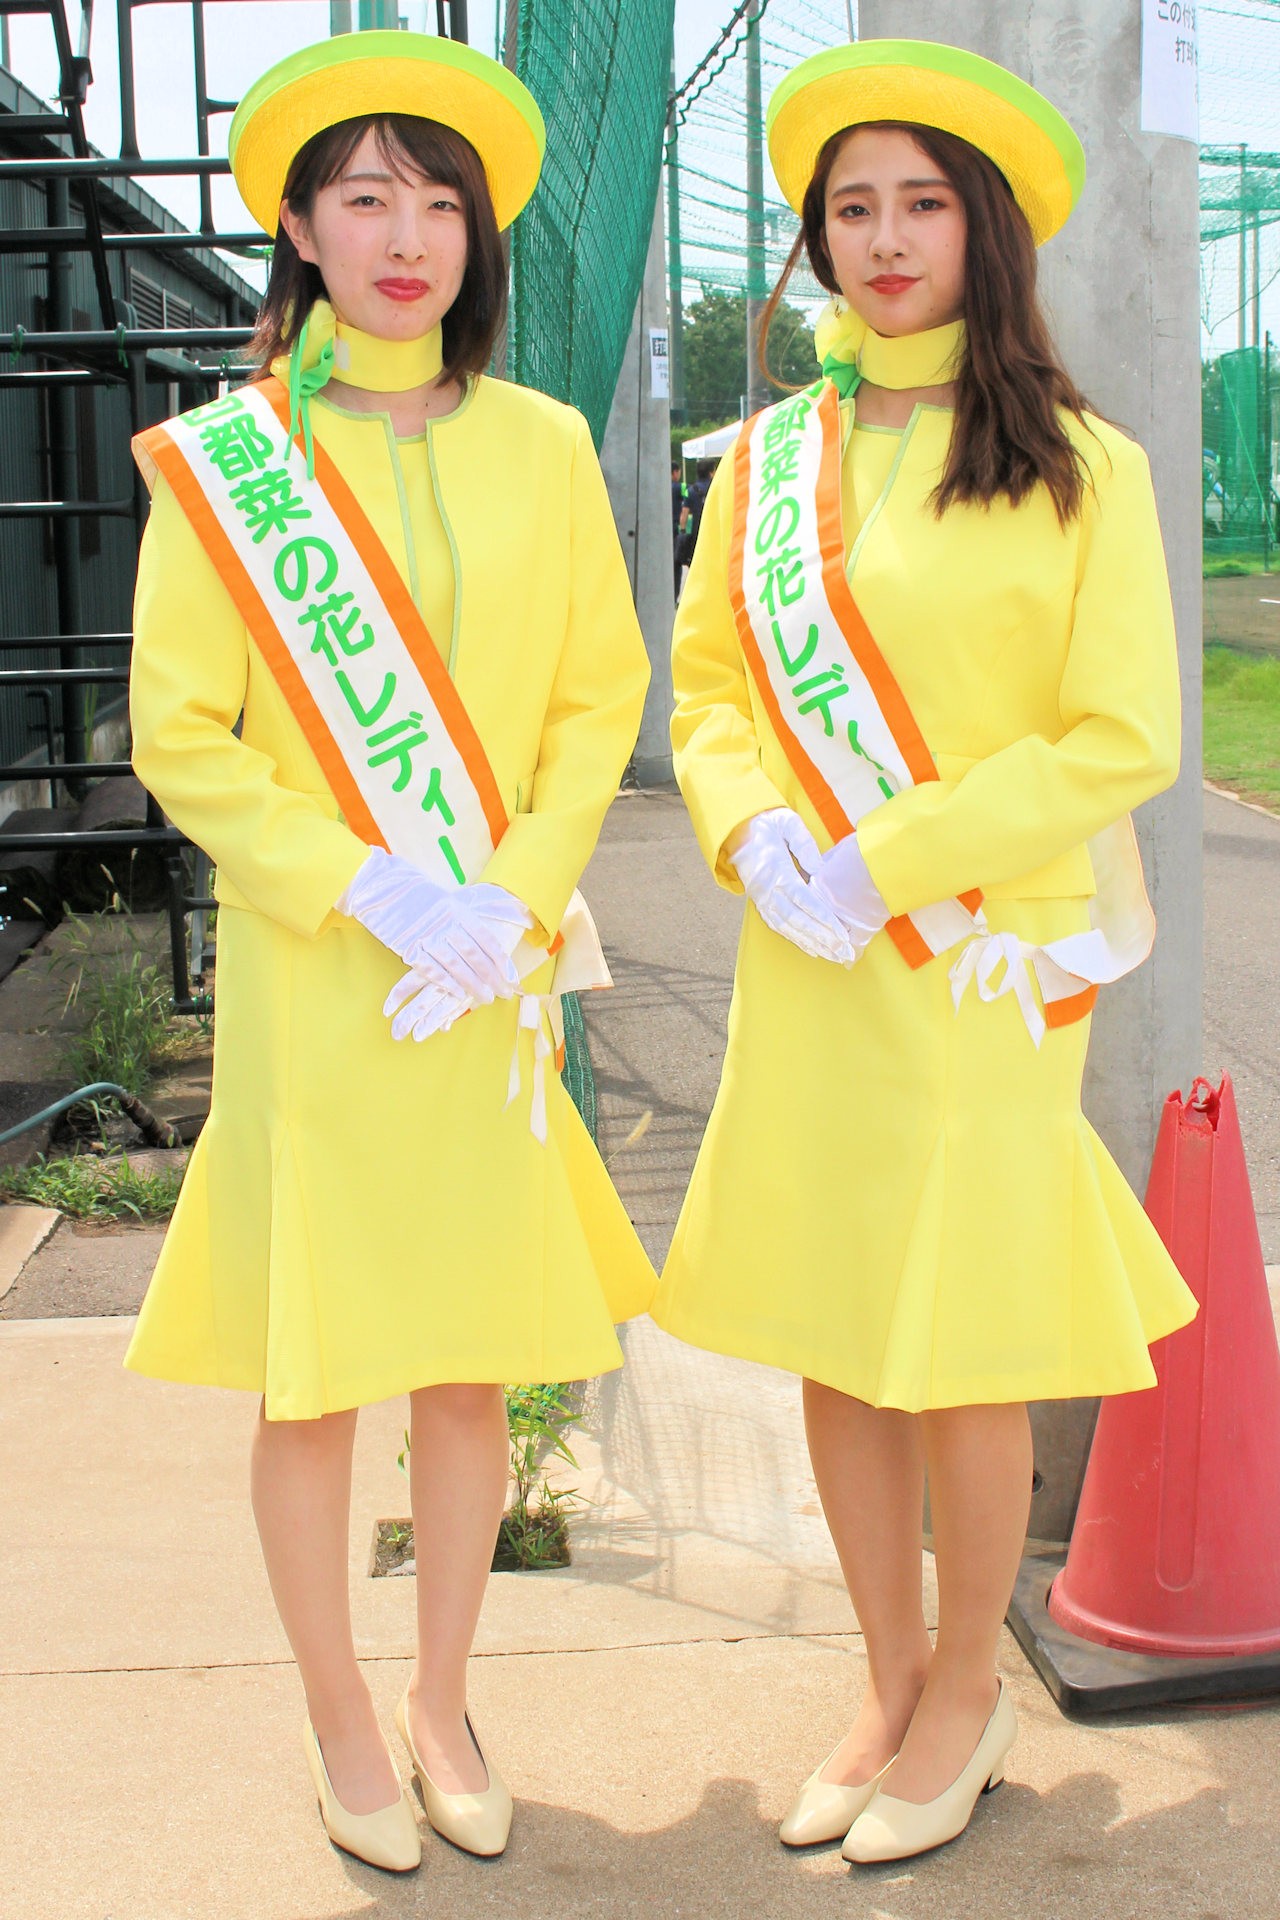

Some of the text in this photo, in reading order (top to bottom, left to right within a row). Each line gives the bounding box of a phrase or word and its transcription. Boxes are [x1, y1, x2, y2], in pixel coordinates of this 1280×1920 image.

[754, 382, 896, 800] 都菜の花レディー
